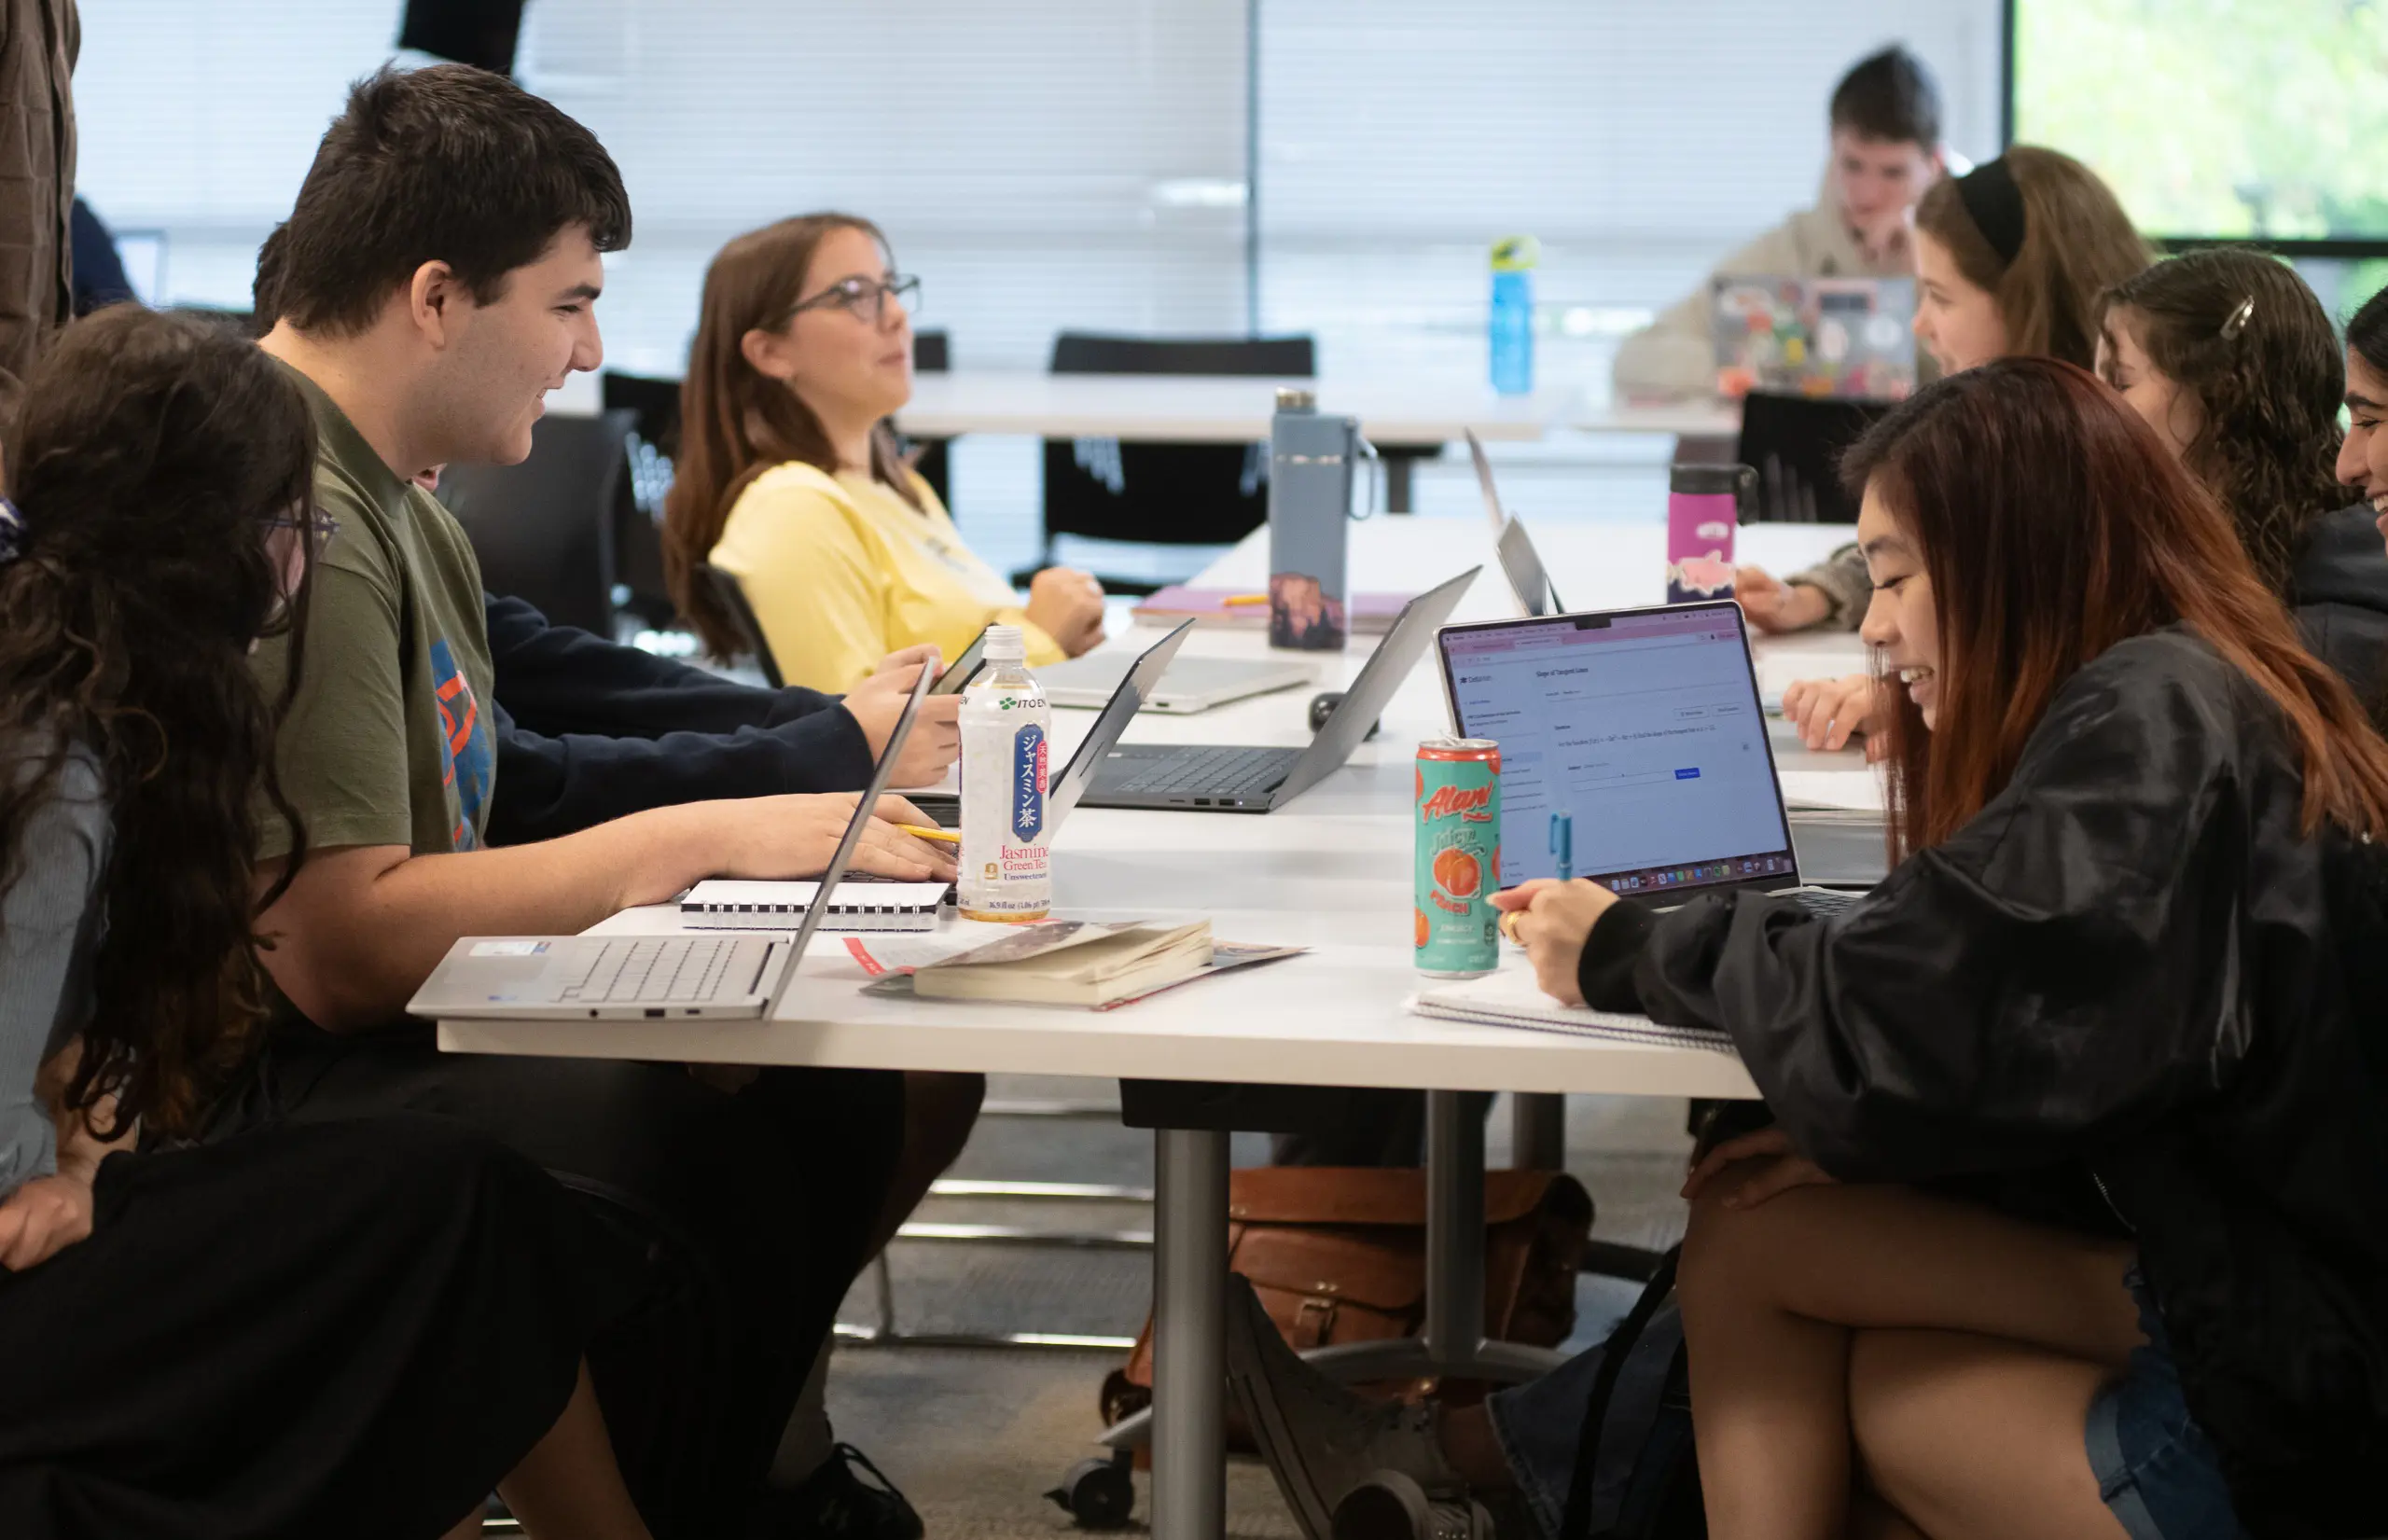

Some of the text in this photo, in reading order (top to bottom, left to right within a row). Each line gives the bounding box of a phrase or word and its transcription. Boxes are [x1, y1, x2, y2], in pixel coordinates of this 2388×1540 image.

[1018, 734, 1037, 828] ジャスミン茶
[1003, 860, 1033, 871] Green
